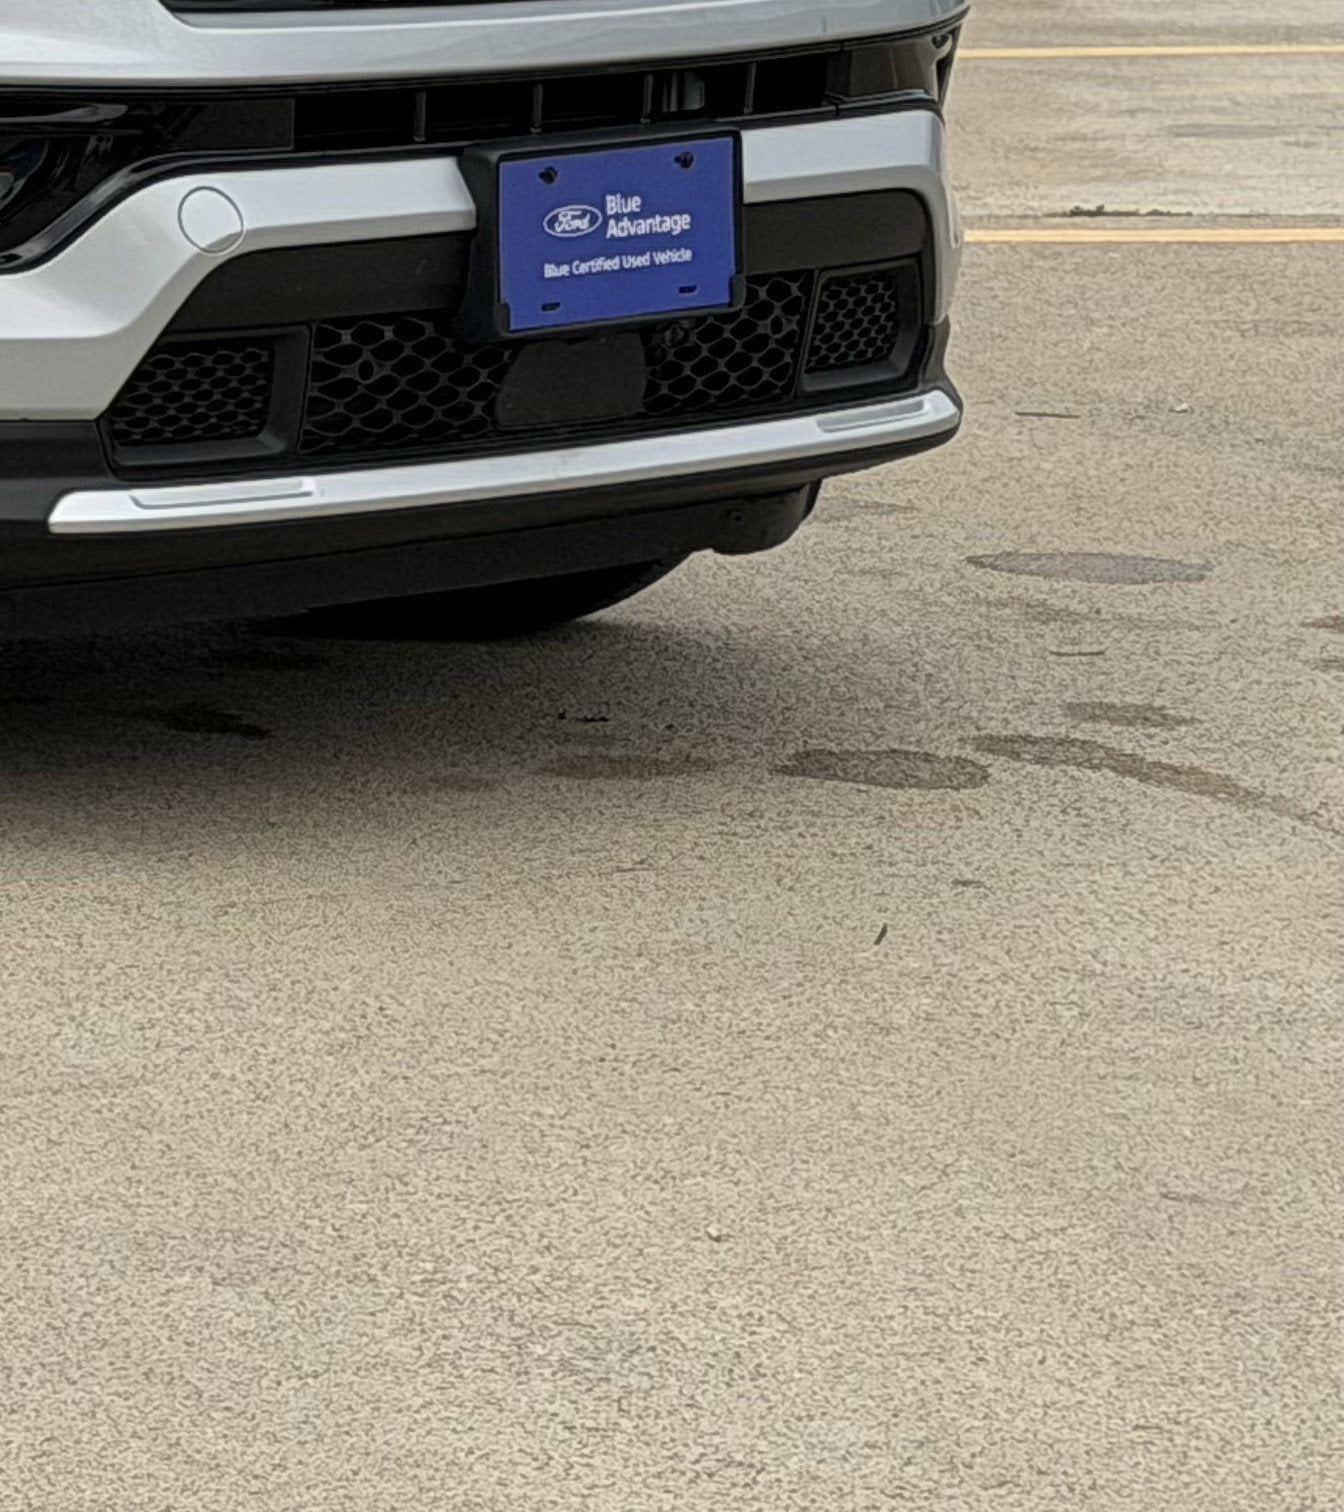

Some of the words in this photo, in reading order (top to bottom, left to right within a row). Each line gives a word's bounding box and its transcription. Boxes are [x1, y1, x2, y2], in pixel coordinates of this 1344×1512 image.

[605, 193, 642, 216] Blue
[605, 213, 691, 239] Advantage
[543, 262, 570, 278] Blue
[572, 256, 621, 275] Certified
[621, 251, 651, 269] Used
[652, 247, 692, 265] Vehicle
